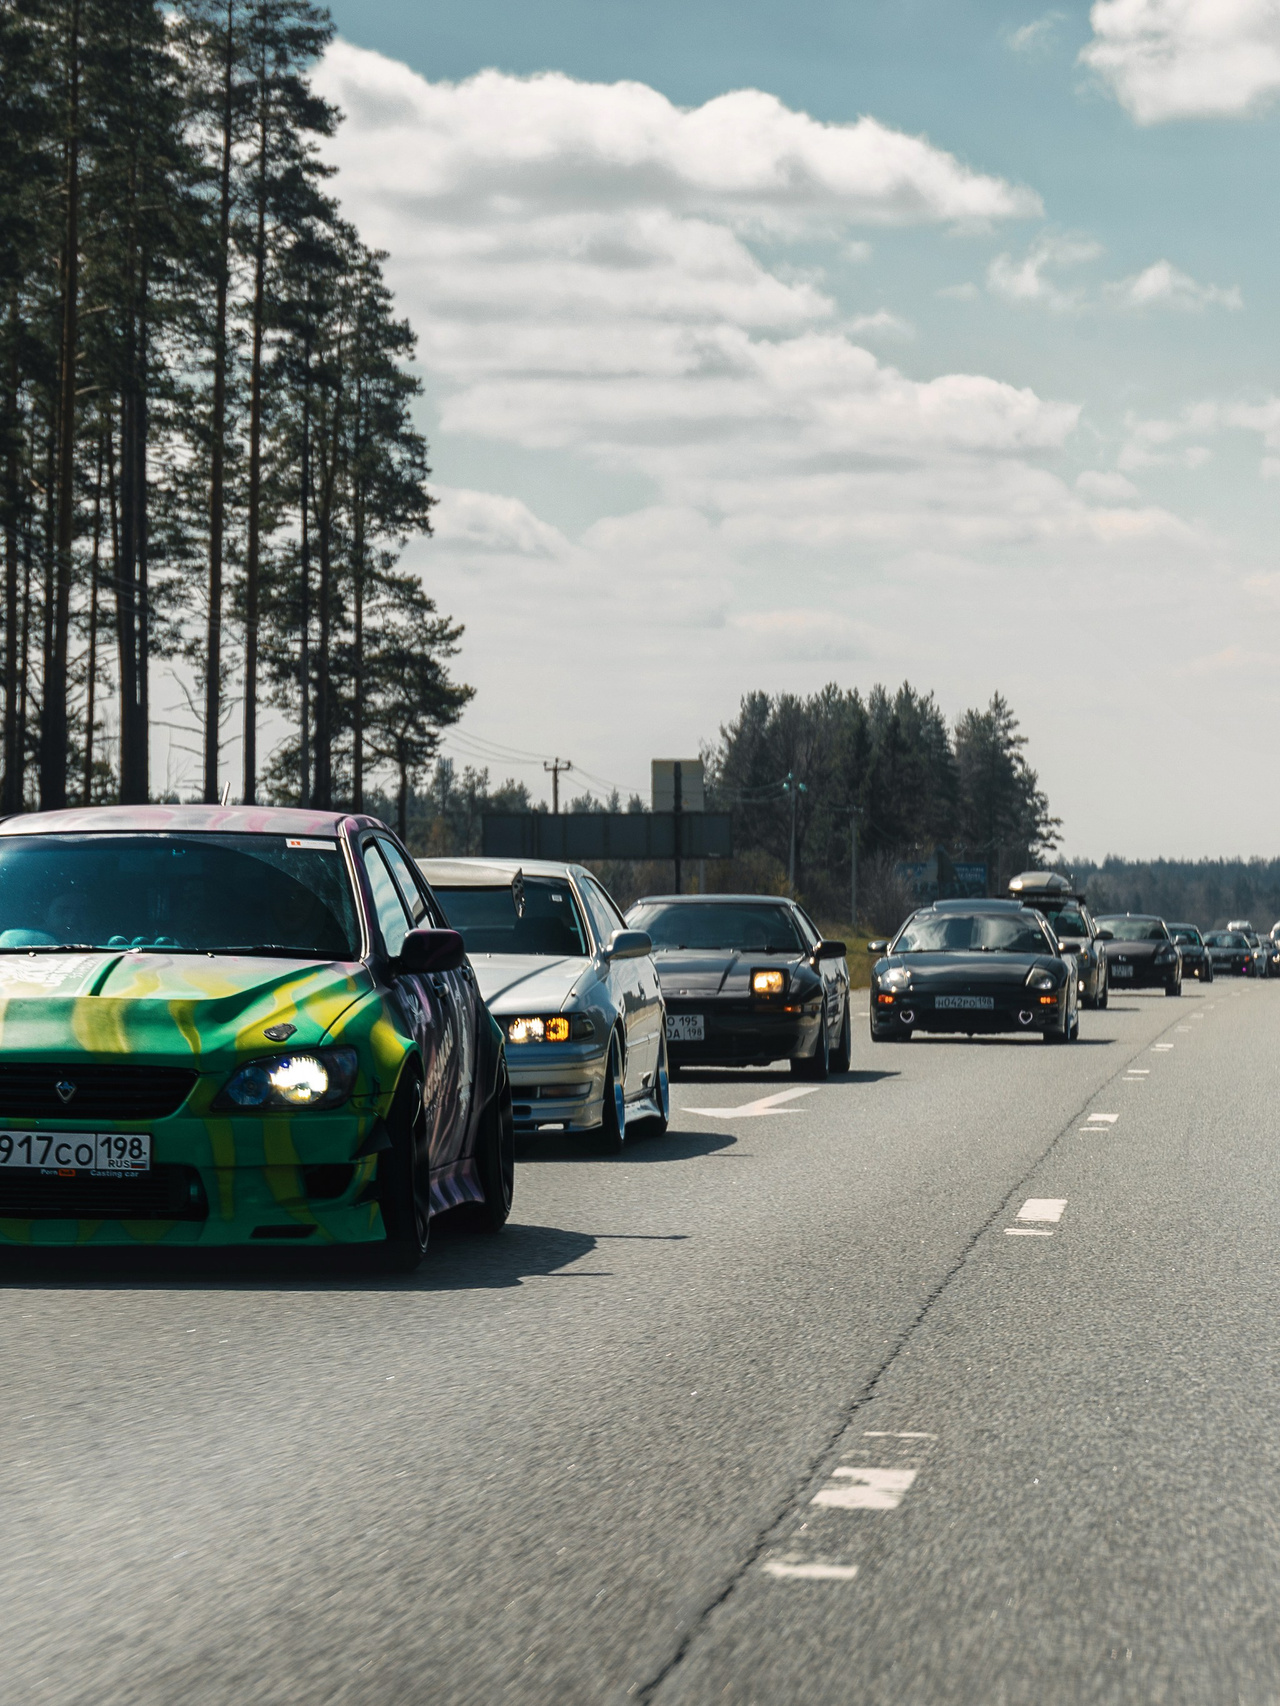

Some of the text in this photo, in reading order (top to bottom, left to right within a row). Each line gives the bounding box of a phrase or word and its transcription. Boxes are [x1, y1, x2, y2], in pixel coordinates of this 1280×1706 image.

[679, 1016, 698, 1027] 195
[100, 1136, 142, 1159] 198
[108, 1159, 131, 1168] RUS
[40, 1168, 58, 1176] Porn
[90, 1169, 123, 1178] Casting
